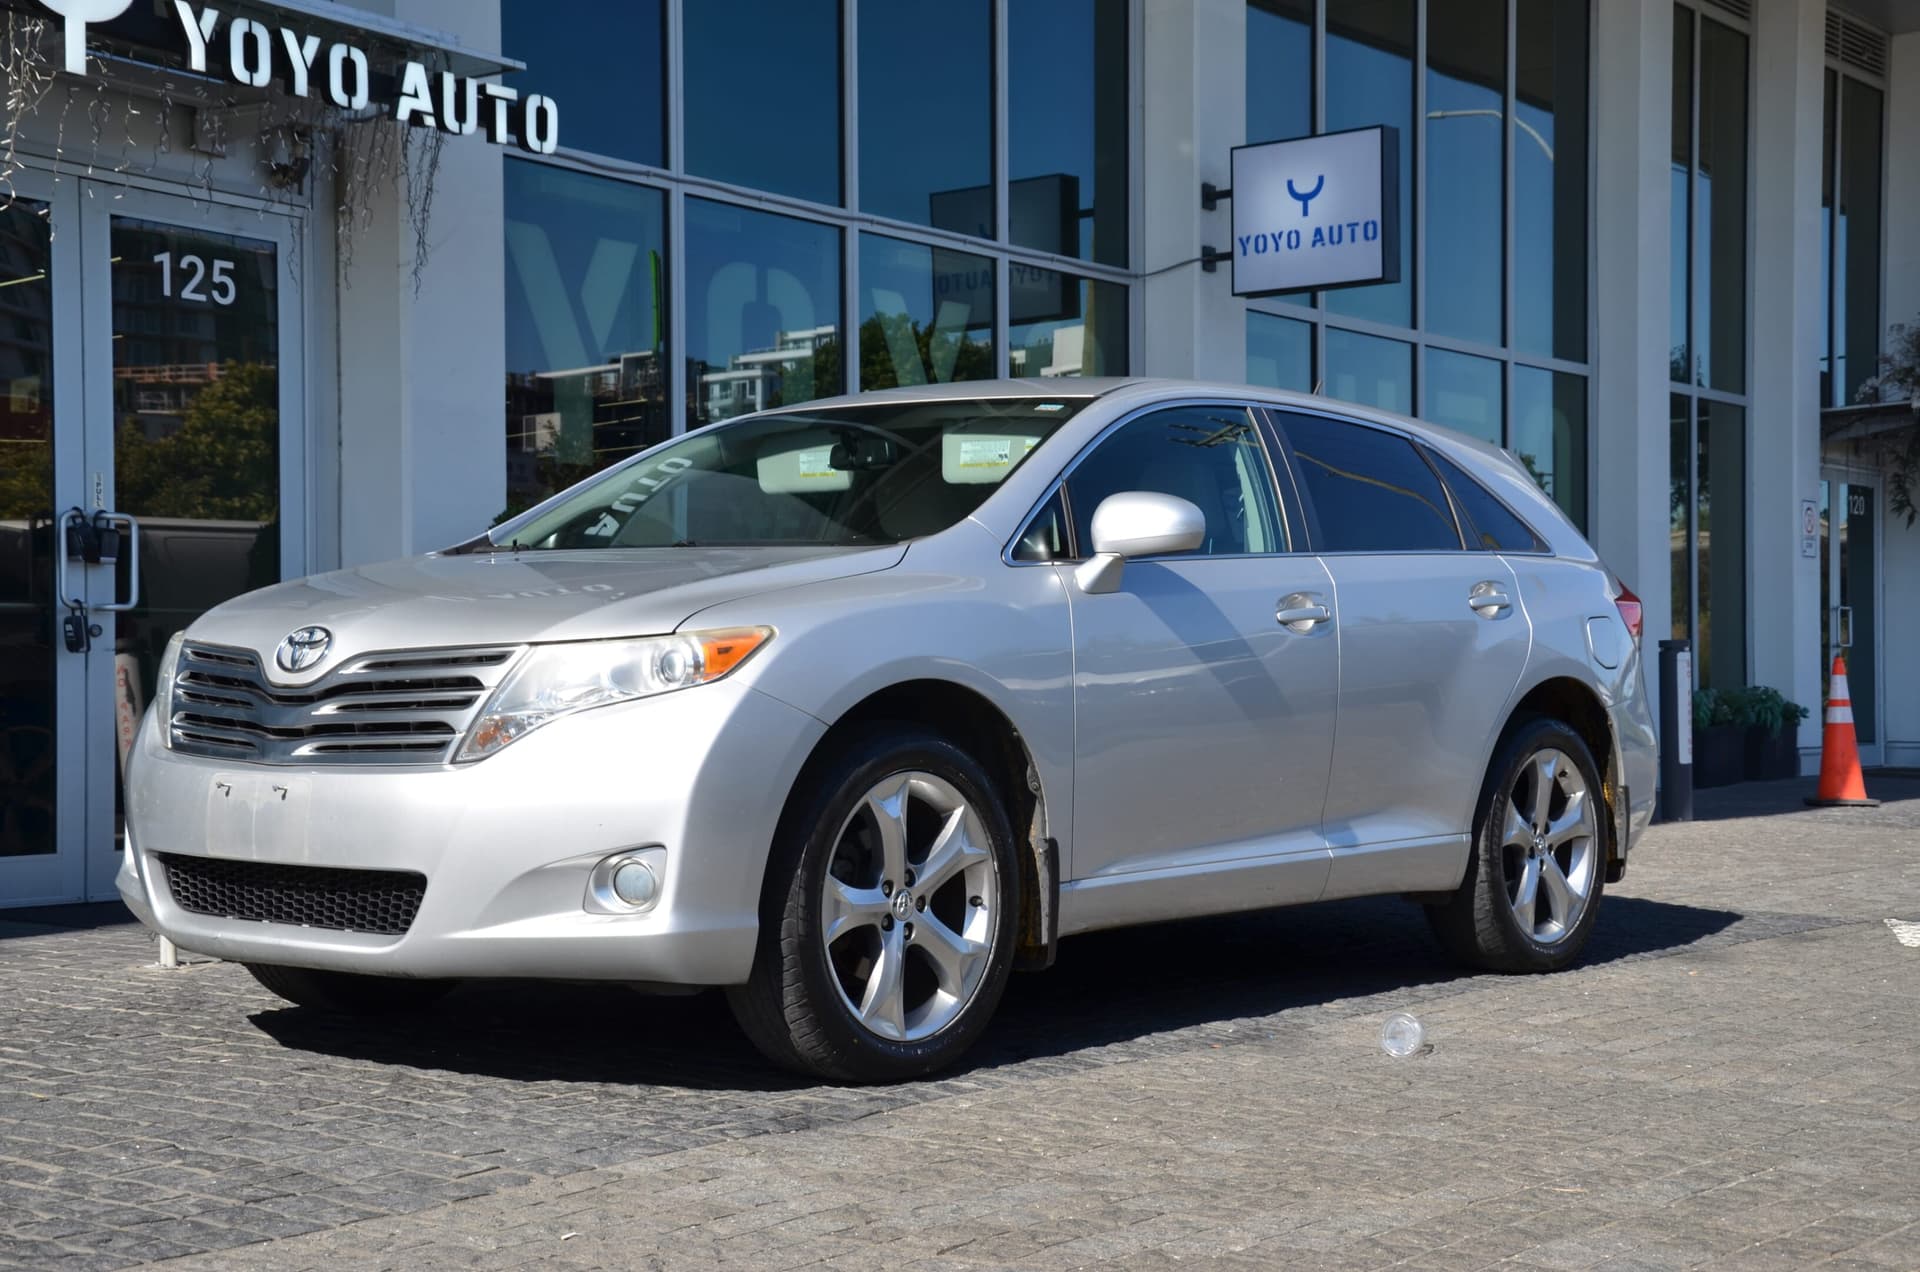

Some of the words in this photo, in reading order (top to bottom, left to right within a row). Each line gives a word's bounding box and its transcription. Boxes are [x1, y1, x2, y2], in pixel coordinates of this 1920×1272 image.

[176, 0, 369, 111] YOYO
[397, 61, 559, 155] AUTO
[1238, 229, 1300, 257] YOYO
[1311, 219, 1378, 248] AUTO
[153, 251, 236, 305] 125
[1849, 495, 1865, 515] 120
